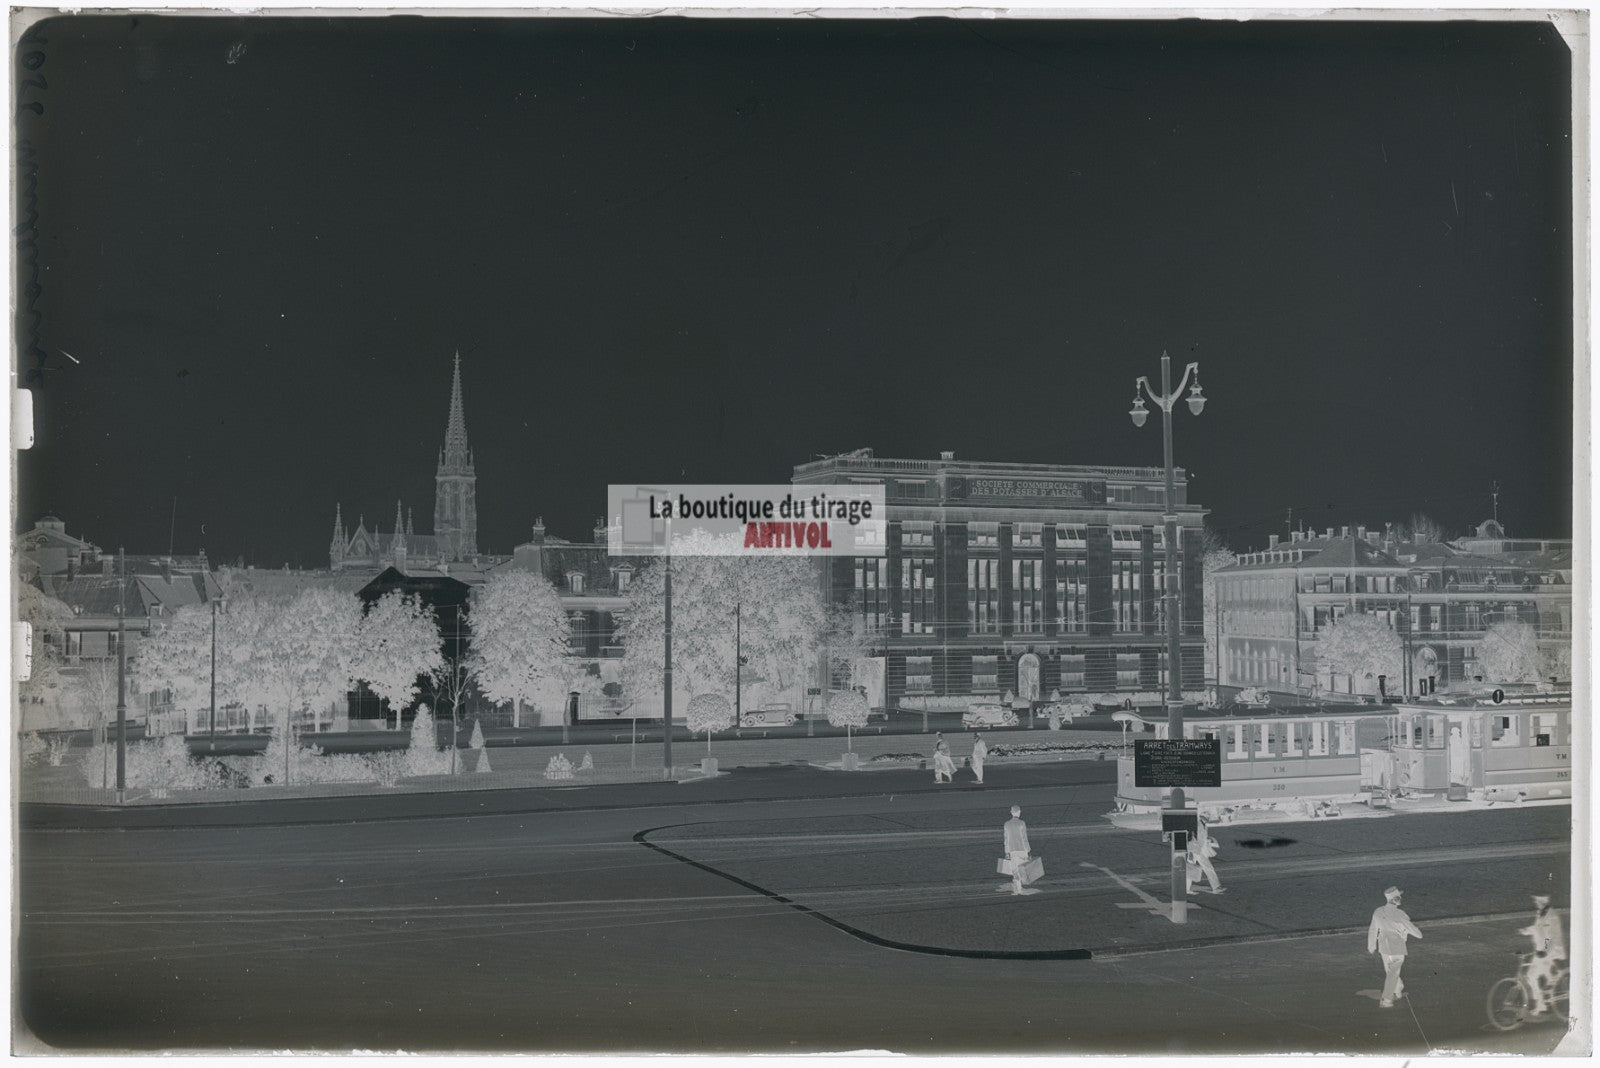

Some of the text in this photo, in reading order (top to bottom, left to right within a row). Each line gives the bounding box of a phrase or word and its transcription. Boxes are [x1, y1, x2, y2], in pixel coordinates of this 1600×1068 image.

[1016, 482, 1079, 490] COMMERCIALE
[972, 487, 1082, 497] DES POTASSES D'ALSACE
[1176, 741, 1213, 749] TRAMWAYS
